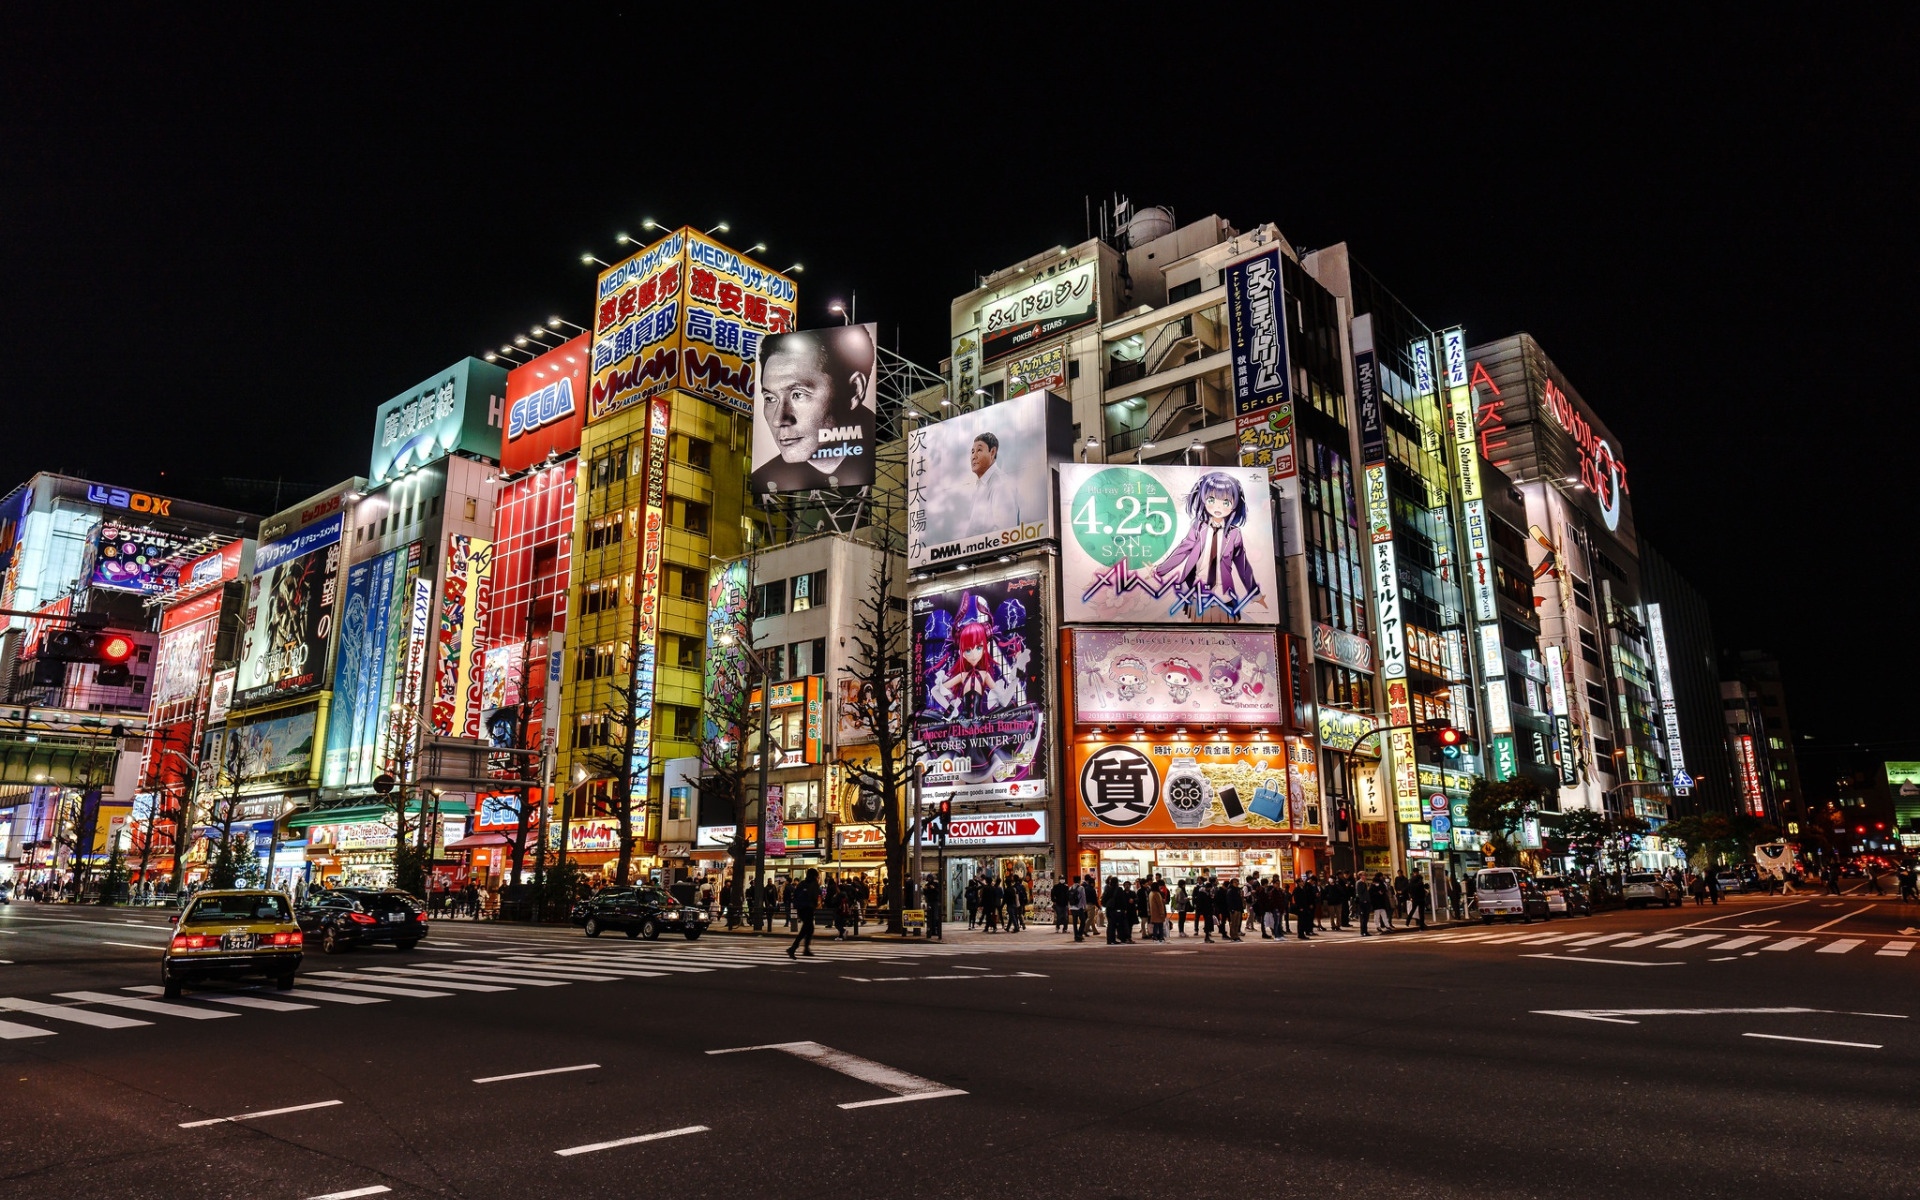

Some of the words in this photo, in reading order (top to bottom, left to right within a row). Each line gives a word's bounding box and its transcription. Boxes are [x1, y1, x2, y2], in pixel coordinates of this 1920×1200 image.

[599, 233, 682, 299] MEDIAリサイクル
[689, 239, 795, 301] MEDIAリサイクル
[598, 262, 681, 332] 激安販売
[690, 265, 796, 334] 激安販売
[987, 274, 1089, 331] メイドカジノ
[594, 302, 677, 373] 高額買取
[1012, 330, 1032, 344] POKER
[592, 348, 678, 416] Mulan
[1237, 355, 1249, 398] 秋葉原店
[508, 376, 576, 440] SEGA
[623, 392, 642, 407] AKIBA
[651, 436, 665, 446] DVD
[818, 425, 863, 442] DMM
[1240, 427, 1290, 449] まんが
[1455, 410, 1466, 440] Yellow
[811, 442, 863, 460] .make
[909, 429, 927, 566] 次は太陽か。
[1073, 495, 1173, 536] 4.25
[1001, 521, 1044, 546] solar
[1113, 535, 1141, 547] ON
[1102, 545, 1153, 557] SALE
[317, 543, 341, 640] 絶望の
[415, 582, 430, 627] AKKY
[410, 639, 424, 664] Tax
[550, 650, 561, 682] SEGA
[1388, 683, 1410, 726] 免税
[969, 735, 1010, 749] WINTER
[1012, 733, 1032, 744] 2019
[1154, 745, 1172, 755] 時計
[1175, 745, 1201, 755] バッグ
[1204, 745, 1231, 755] 貴金属
[1234, 745, 1259, 755] ダイヤ
[1262, 745, 1280, 755] 携帯
[1402, 731, 1413, 758] TAX
[1557, 718, 1574, 783] GALLERIA
[1090, 756, 1153, 817] 質
[1366, 776, 1378, 814] ルノアール
[1406, 762, 1418, 798] FREE
[571, 822, 611, 846] Mulan
[949, 822, 994, 837] COMIC
[997, 820, 1017, 835] ZIN
[661, 844, 688, 856] ラーメン
